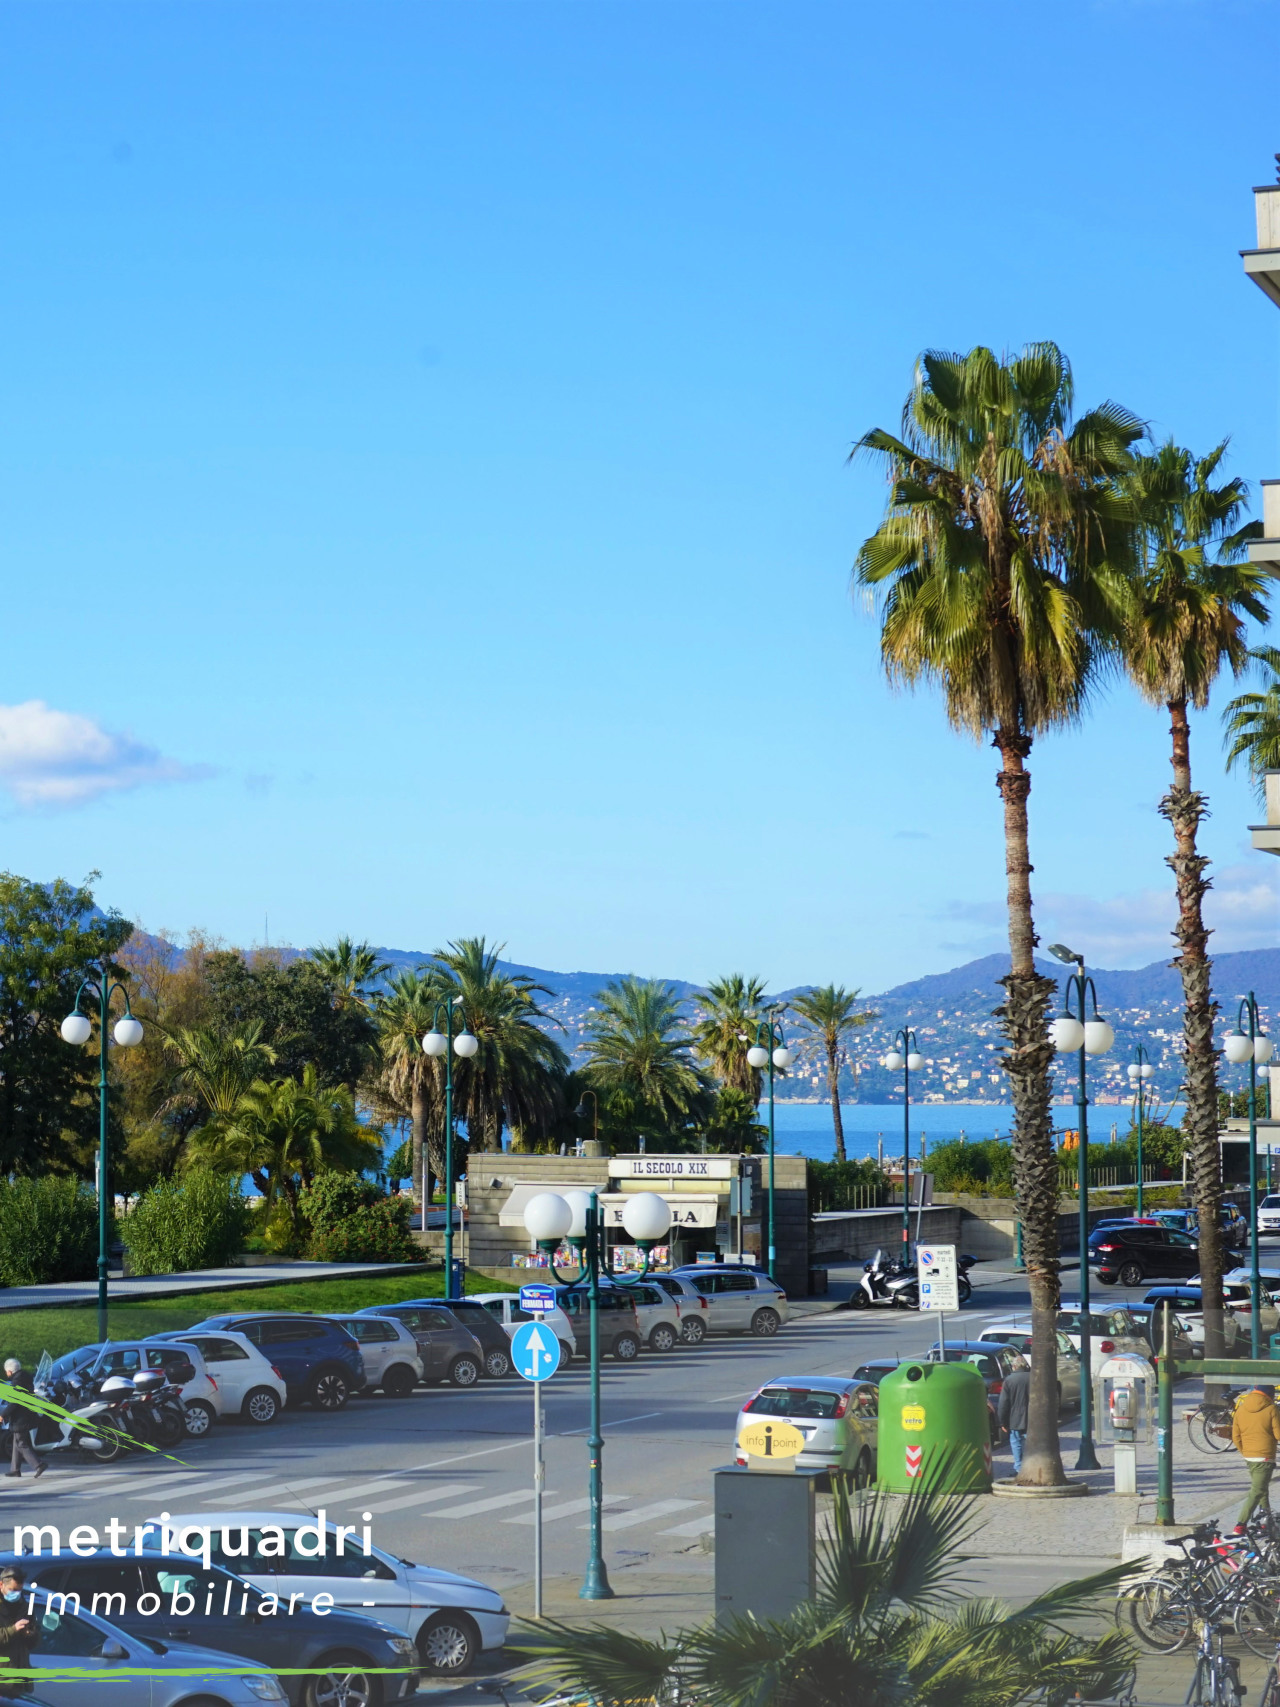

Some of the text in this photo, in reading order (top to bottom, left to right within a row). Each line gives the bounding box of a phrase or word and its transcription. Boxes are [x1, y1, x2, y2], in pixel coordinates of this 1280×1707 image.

[633, 1162, 708, 1175] IL SECOLO XIX
[746, 1435, 765, 1446] info
[773, 1438, 797, 1448] point
